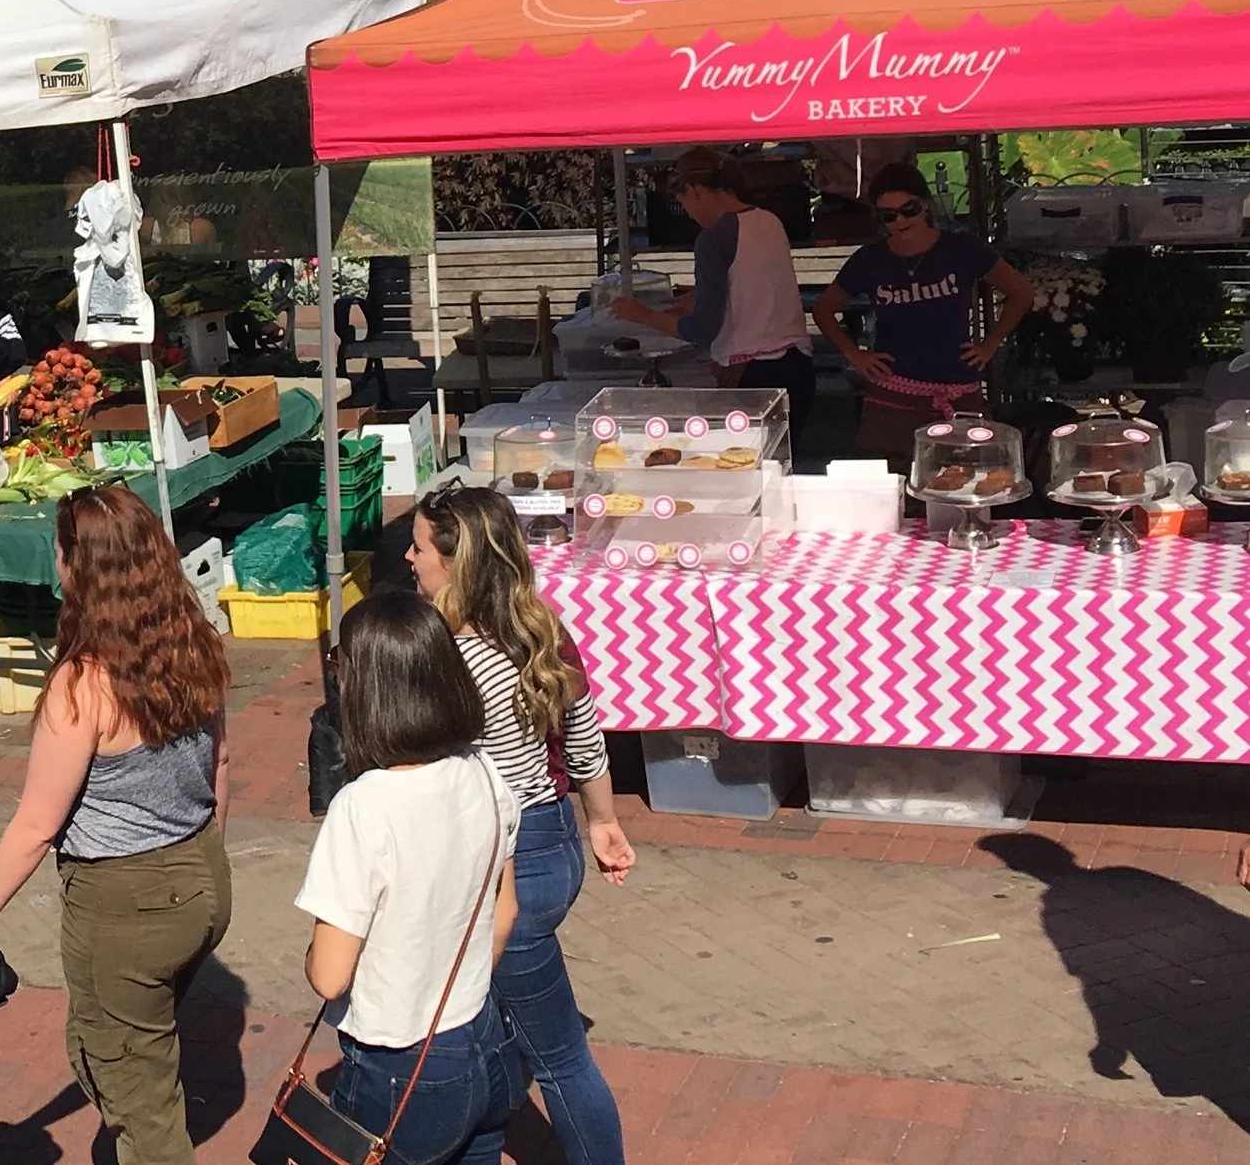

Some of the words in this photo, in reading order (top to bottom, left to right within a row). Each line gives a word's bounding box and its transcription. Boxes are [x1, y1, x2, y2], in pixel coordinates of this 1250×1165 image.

[39, 72, 85, 89] Eurmax
[670, 41, 815, 122] Yummy
[810, 31, 1007, 114] Mummy
[807, 95, 928, 121] BAKERY
[166, 202, 237, 226] grown
[876, 273, 959, 305] Salut!
